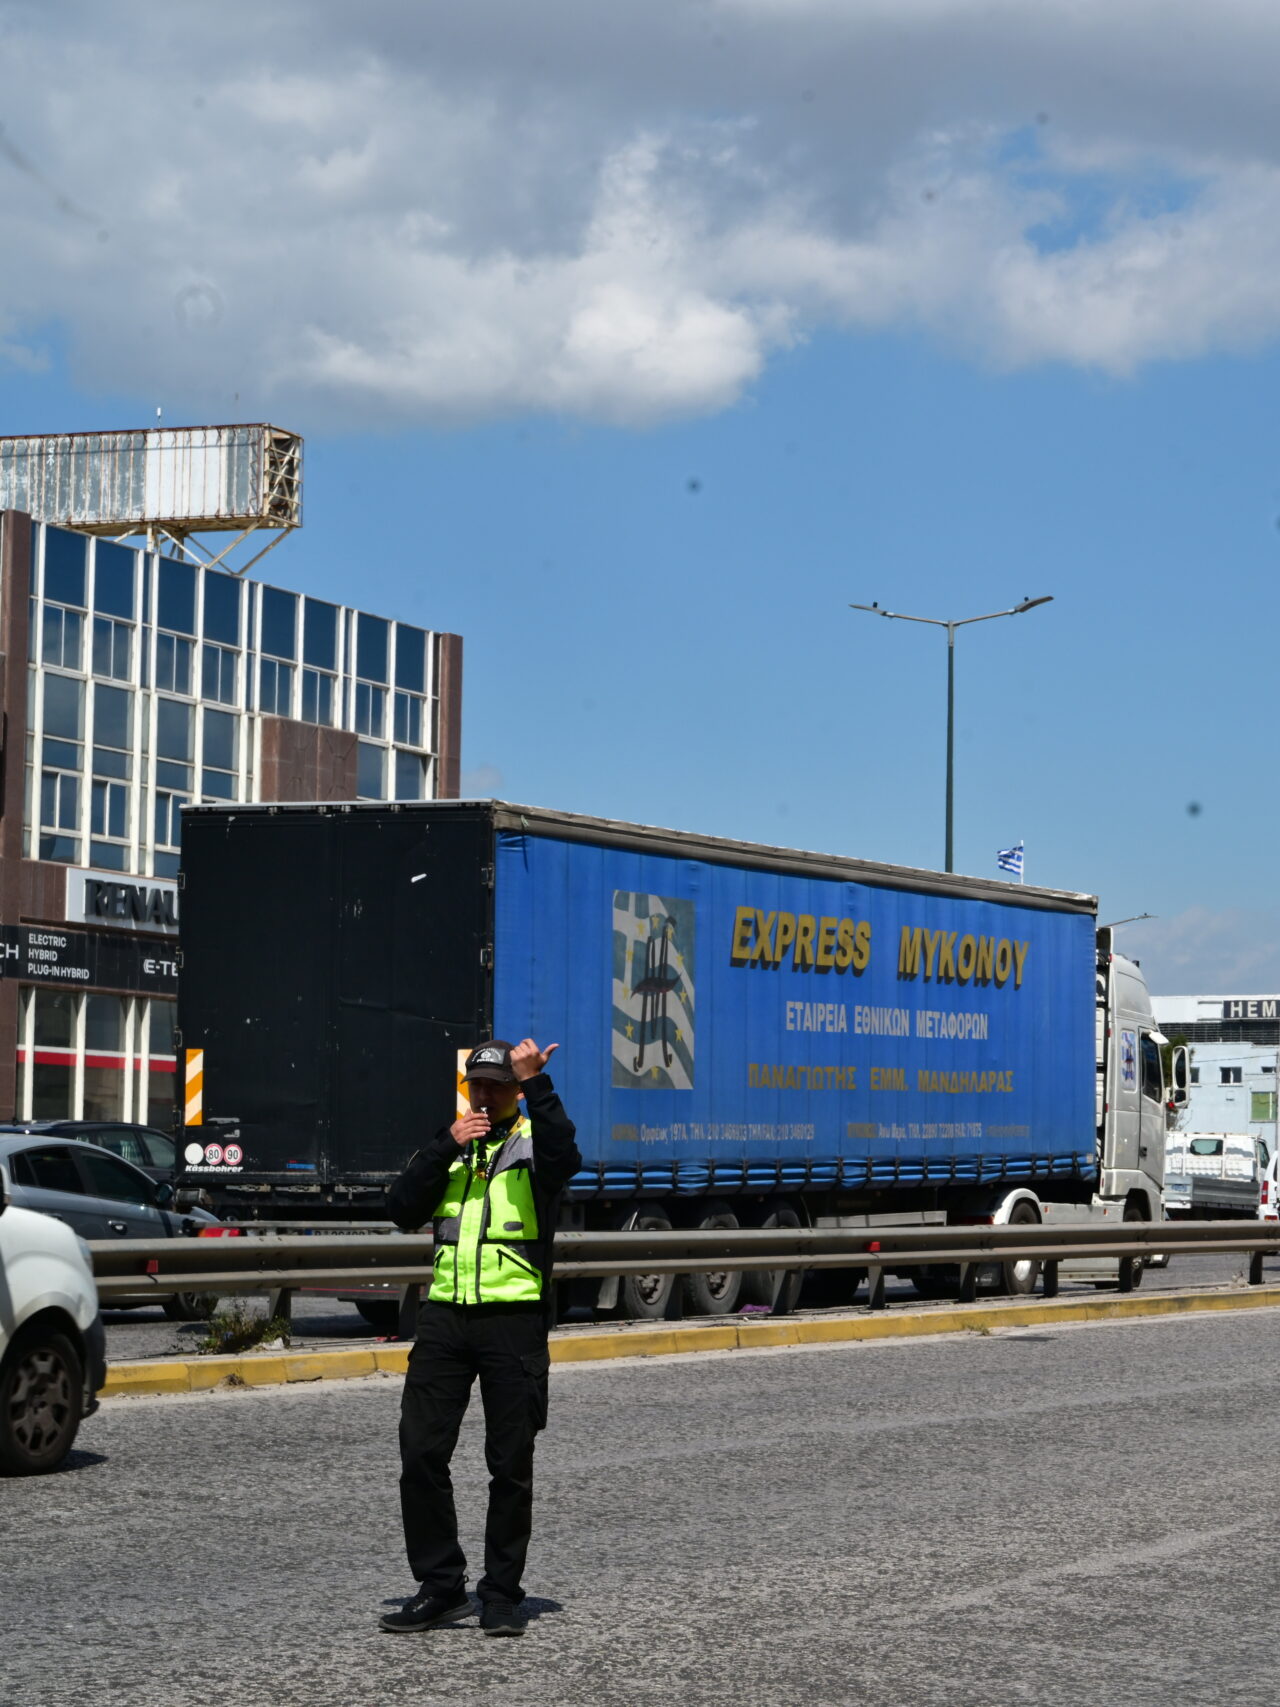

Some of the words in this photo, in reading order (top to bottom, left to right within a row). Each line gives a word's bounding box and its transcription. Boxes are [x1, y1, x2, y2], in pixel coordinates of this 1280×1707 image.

[29, 933, 67, 948] ELECTRIC
[730, 906, 872, 976] EXPRESS
[28, 948, 58, 961] HYBRID
[61, 966, 90, 980] HYBRID
[208, 1149, 220, 1160] 80
[227, 1149, 239, 1160] 90
[185, 1164, 244, 1174] Kässbohrer
